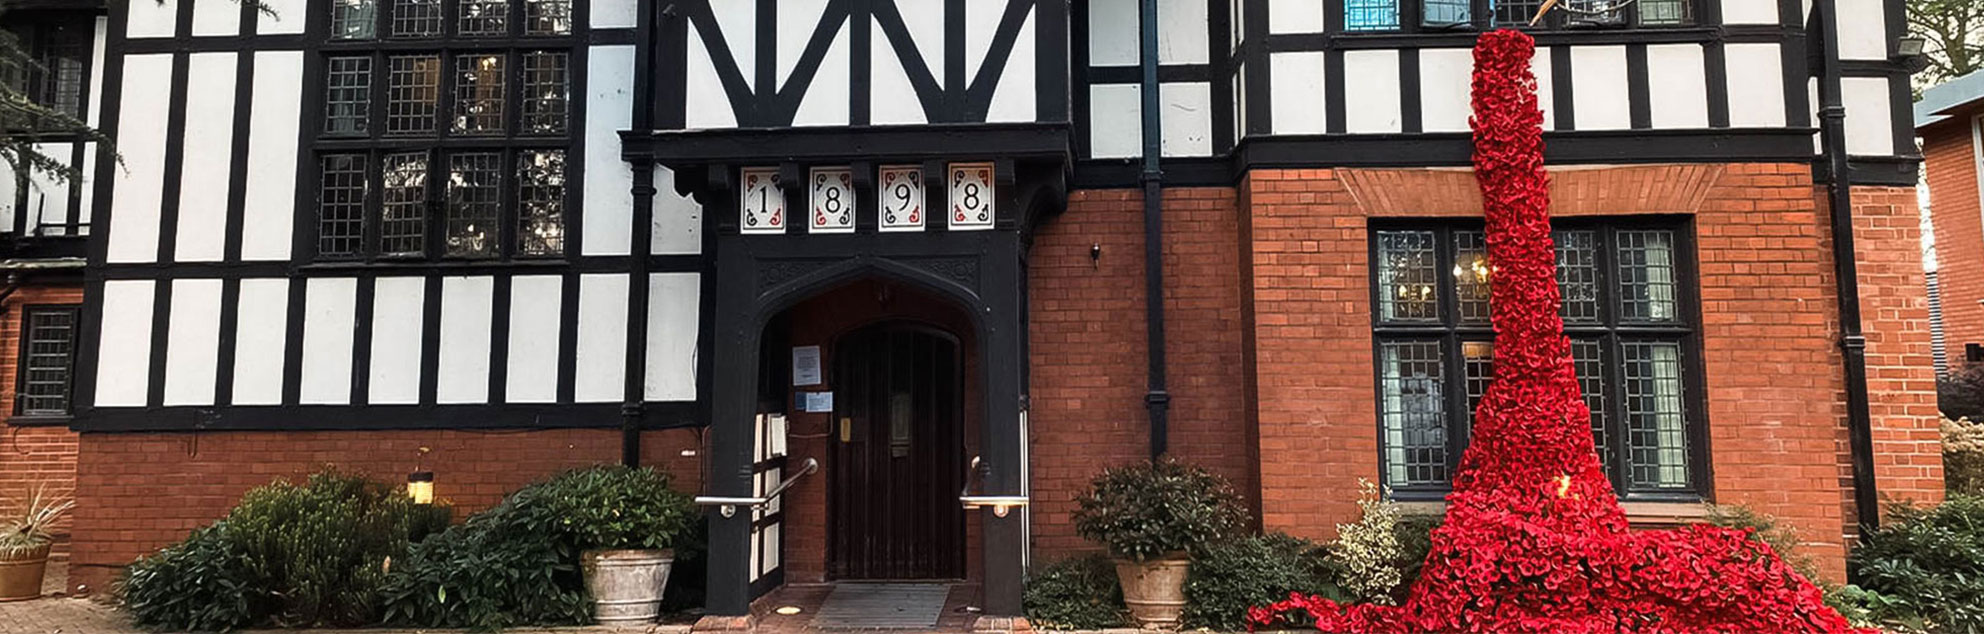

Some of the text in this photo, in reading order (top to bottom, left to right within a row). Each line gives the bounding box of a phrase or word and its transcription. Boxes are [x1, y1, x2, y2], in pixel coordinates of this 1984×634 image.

[759, 183, 979, 213] 1 8 9 8
